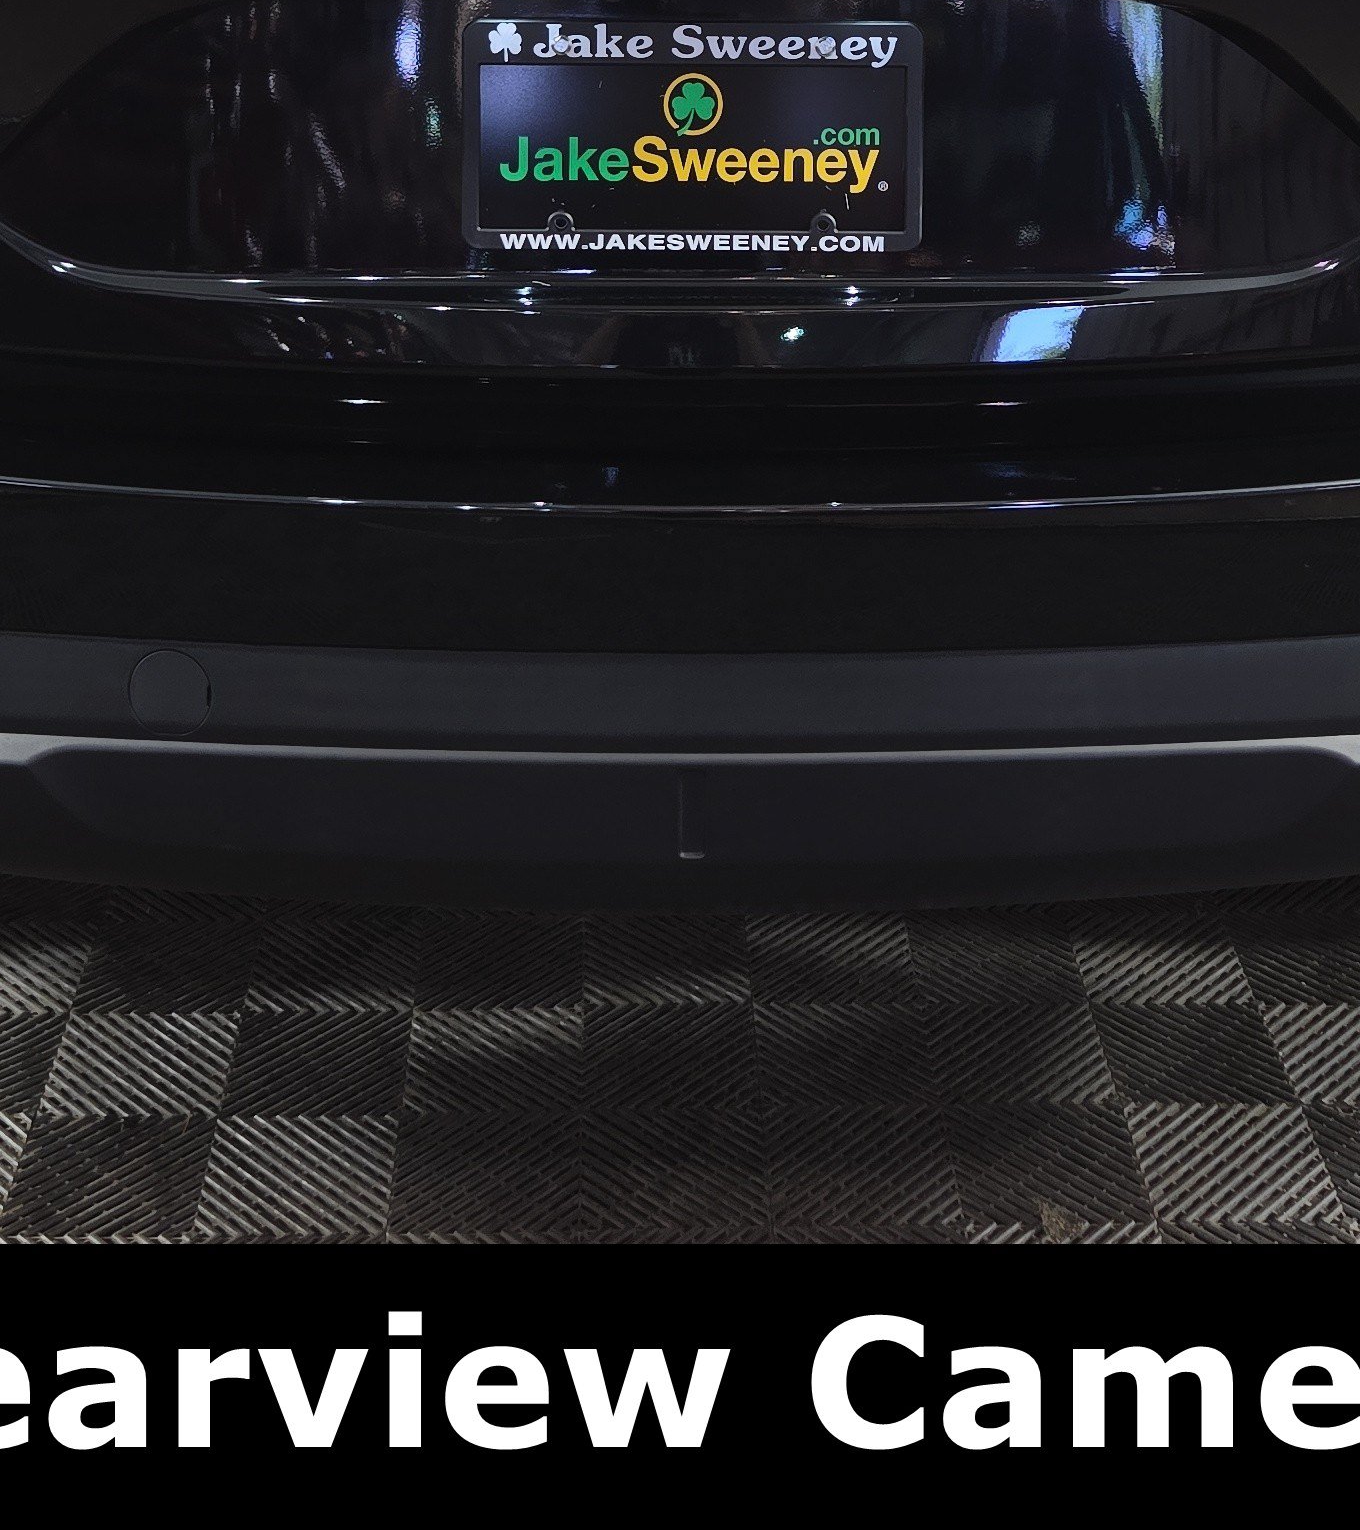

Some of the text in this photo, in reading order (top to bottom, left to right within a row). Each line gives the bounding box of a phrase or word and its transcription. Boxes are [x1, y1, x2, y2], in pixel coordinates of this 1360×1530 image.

[533, 23, 898, 68] Jake Sweeney
[500, 233, 886, 253] WWW.JAKESWEENEY.COM
